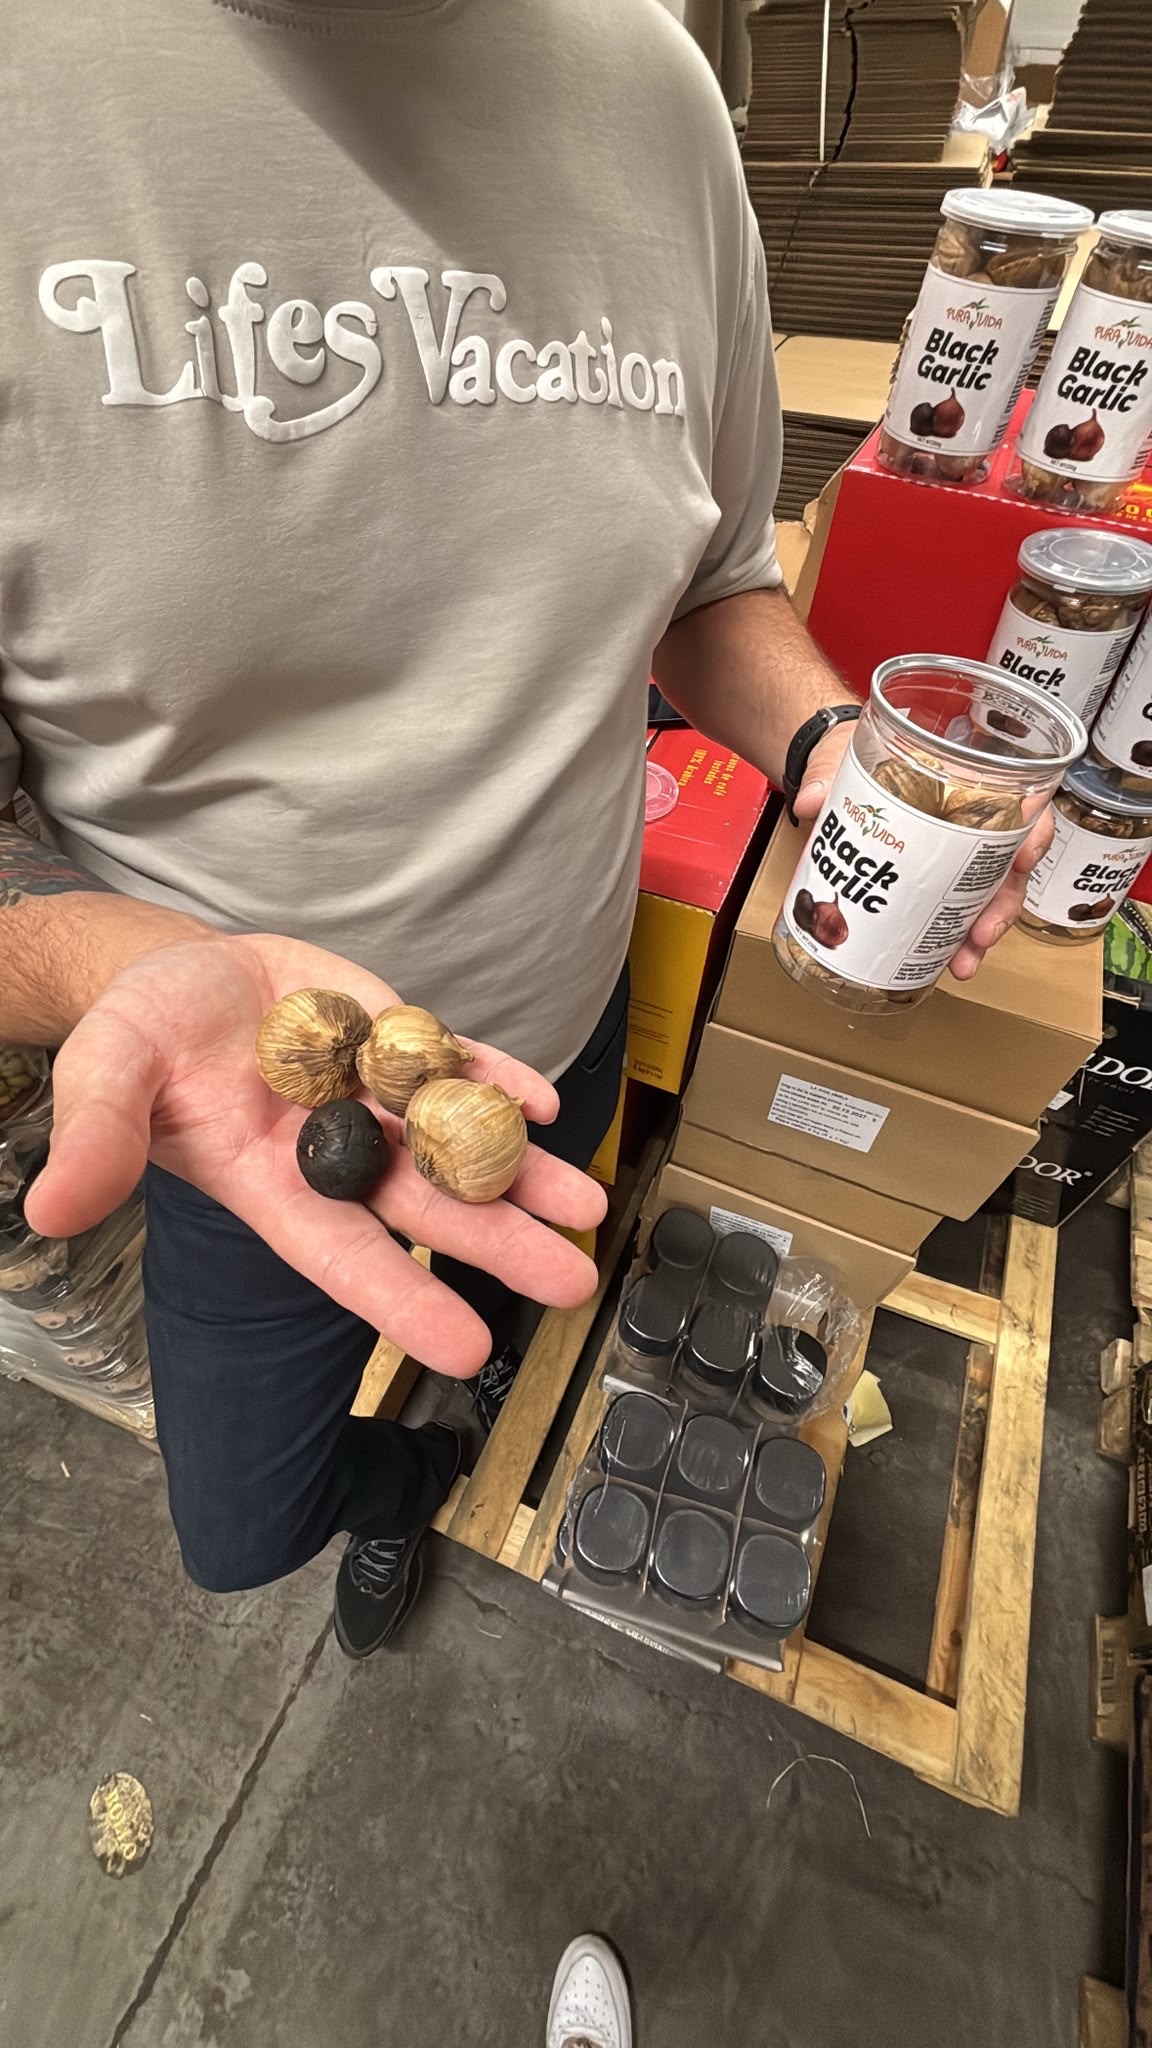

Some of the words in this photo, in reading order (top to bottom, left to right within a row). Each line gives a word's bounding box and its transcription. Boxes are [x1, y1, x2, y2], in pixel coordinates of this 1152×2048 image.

[946, 307, 971, 325] PURA
[977, 312, 1004, 330] VIDA
[1094, 326, 1121, 344] PURA
[38, 259, 383, 444] Lifes
[370, 266, 687, 418] Vacation
[924, 327, 999, 366] Black
[917, 354, 992, 391] Garlic
[1067, 346, 1149, 387] Black
[1057, 374, 1138, 413] Garlic
[999, 648, 1067, 687] Black
[1017, 636, 1038, 654] PURA
[1044, 647, 1069, 661] VIDA
[842, 796, 866, 828] PURA
[871, 822, 906, 854] VIDA
[821, 809, 900, 891] Black
[811, 835, 888, 914] Garlic
[1073, 876, 1135, 894] Garlic
[1080, 862, 1141, 881] Black
